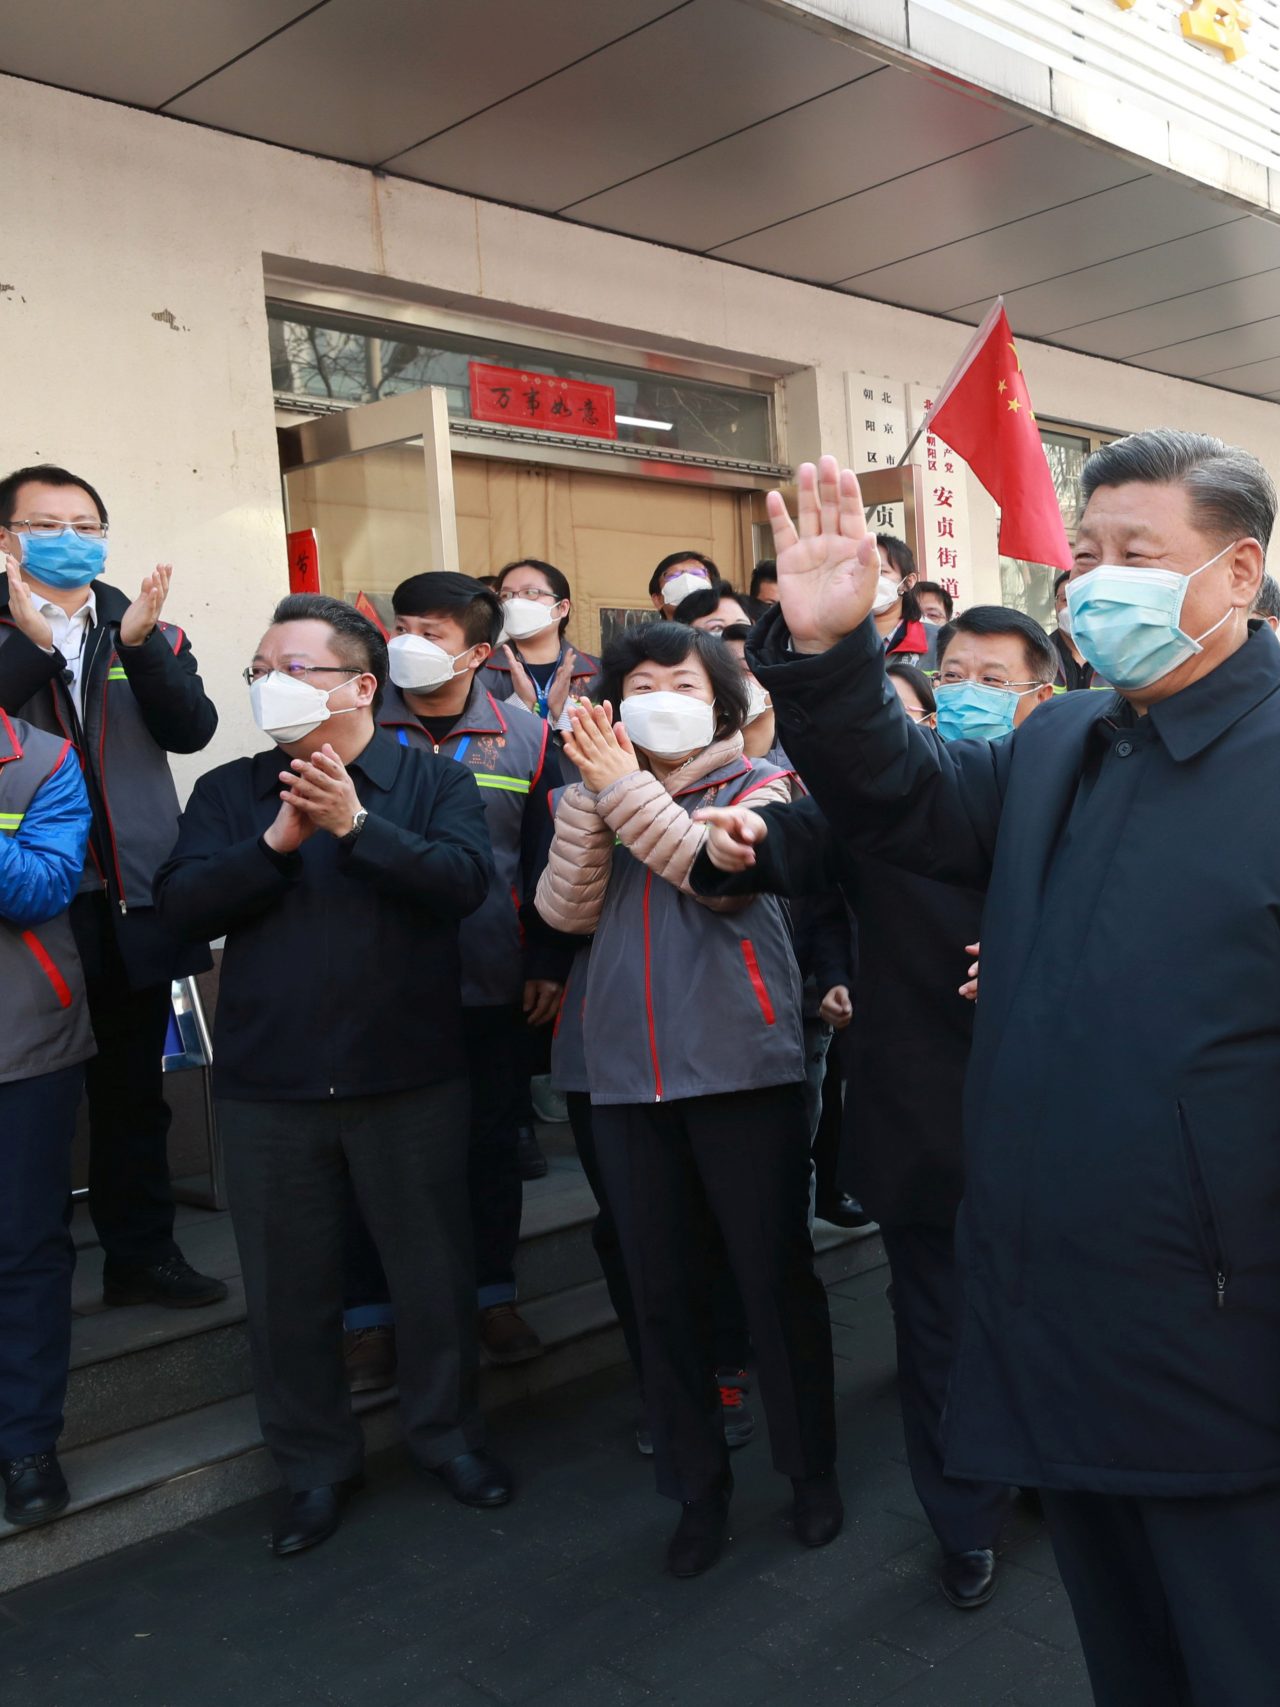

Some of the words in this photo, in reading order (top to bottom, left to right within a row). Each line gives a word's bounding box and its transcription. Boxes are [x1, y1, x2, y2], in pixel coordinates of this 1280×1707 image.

[490, 387, 598, 426] 万事如意
[863, 388, 877, 463] 朝阳区
[882, 391, 894, 465] 北京市
[923, 399, 936, 471] 北朝阳区
[933, 486, 959, 617] 安贞街道
